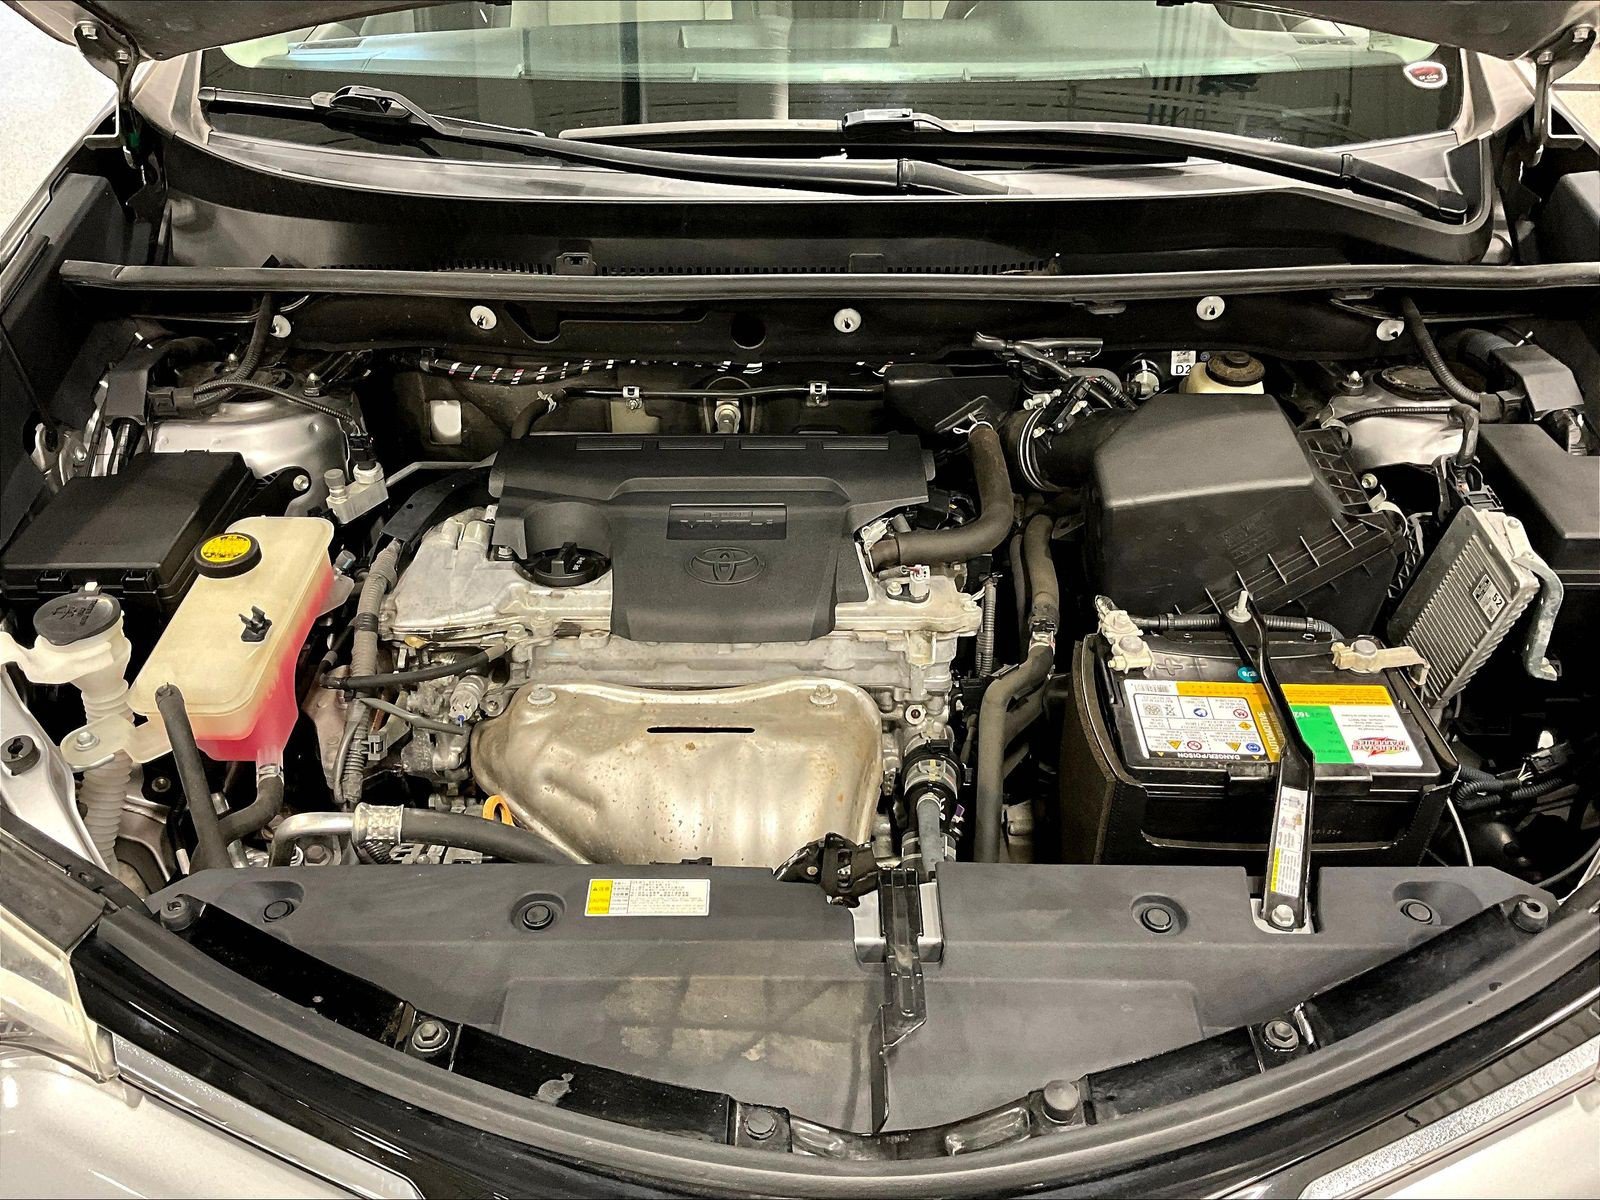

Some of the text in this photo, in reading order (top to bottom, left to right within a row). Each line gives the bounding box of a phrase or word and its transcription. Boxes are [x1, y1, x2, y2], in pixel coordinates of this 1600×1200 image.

[1492, 592, 1503, 608] 52
[1256, 711, 1280, 753] AUTOMOTIVE
[1177, 752, 1240, 760] DANGER/POISON
